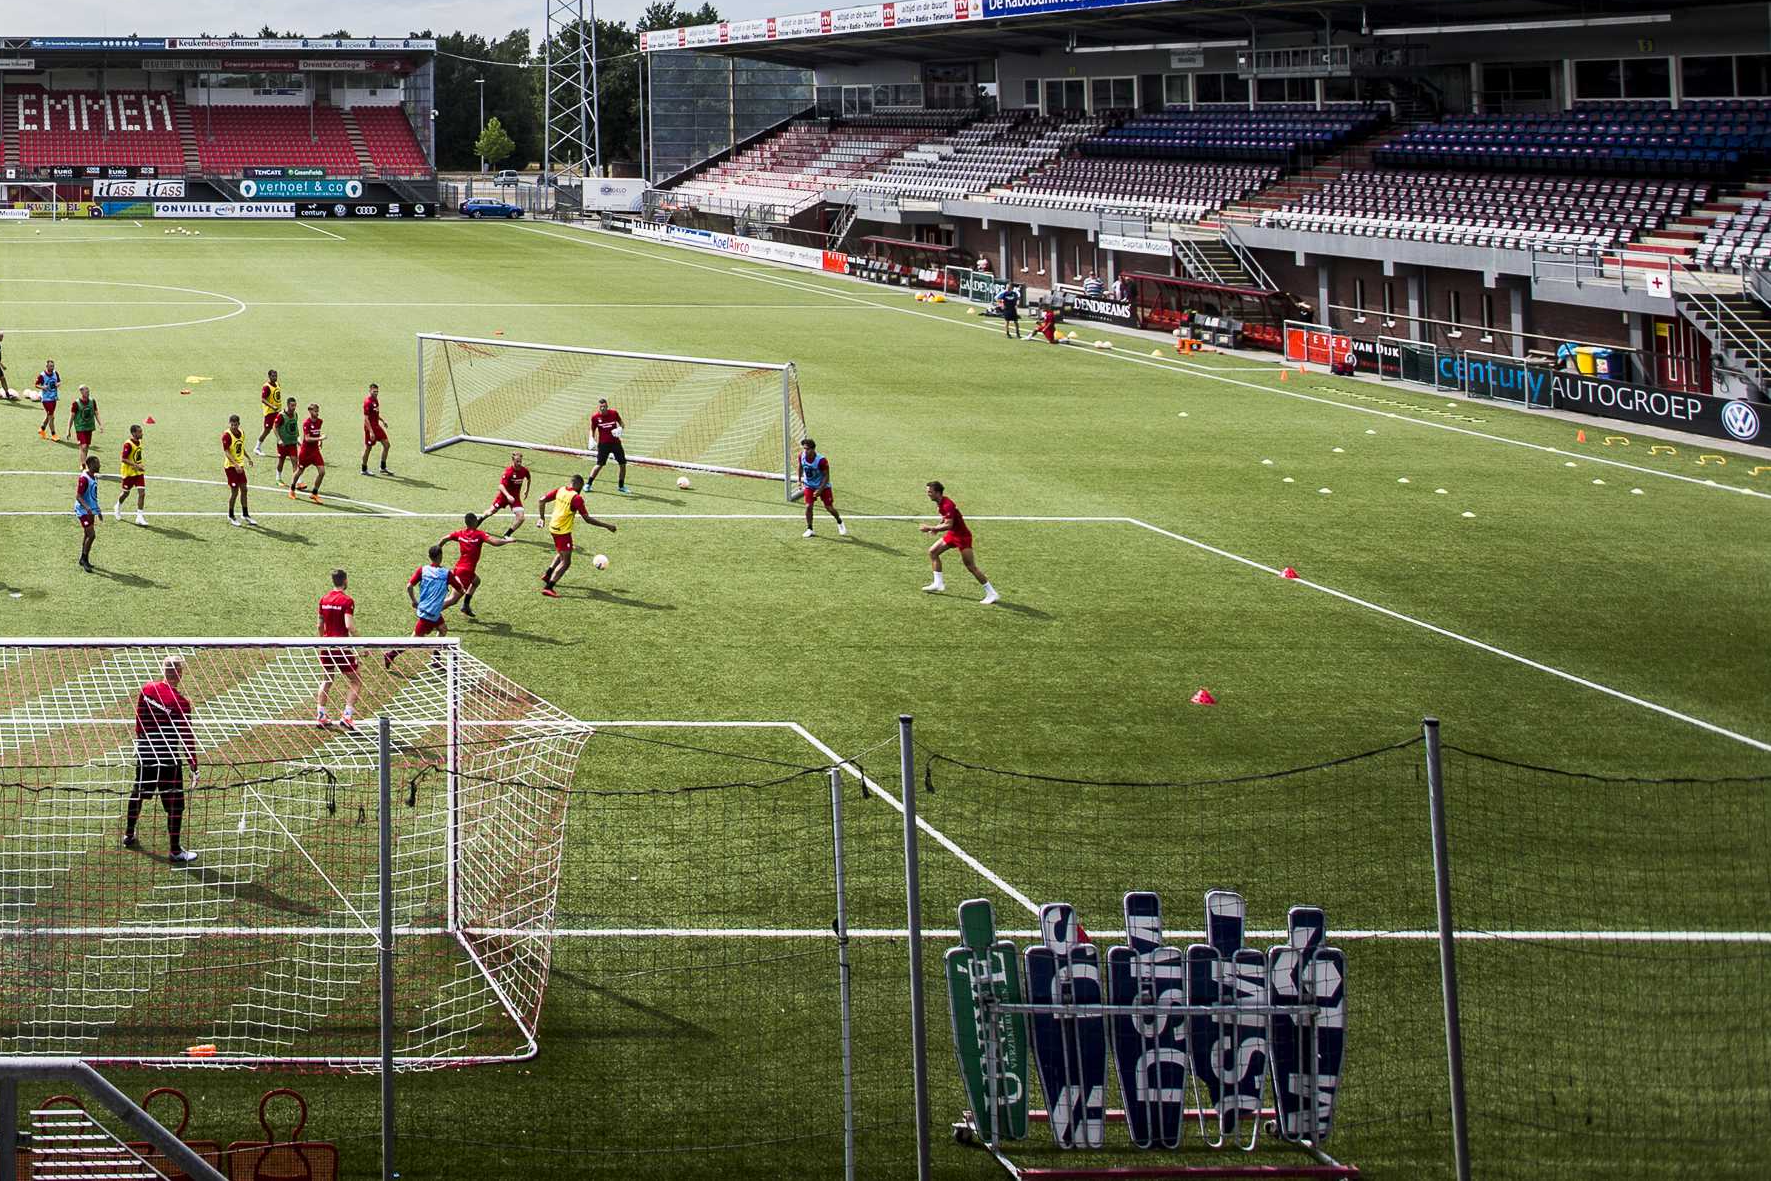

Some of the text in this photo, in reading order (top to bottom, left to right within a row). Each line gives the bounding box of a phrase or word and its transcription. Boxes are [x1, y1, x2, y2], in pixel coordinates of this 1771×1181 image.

[955, 0, 968, 10] rtv
[933, 13, 953, 21] Televisie
[18, 94, 172, 131] EMMEN
[259, 181, 344, 193] verhoef & co
[156, 205, 211, 213] FONVILLE
[240, 205, 295, 213] FONVILLE
[301, 208, 327, 218] century
[1, 210, 28, 219] Mobility
[1146, 241, 1171, 252] Mobility
[1352, 341, 1373, 353] VAN
[1377, 343, 1399, 357] DIJK
[1439, 355, 1701, 420] century AUTOGROEP
